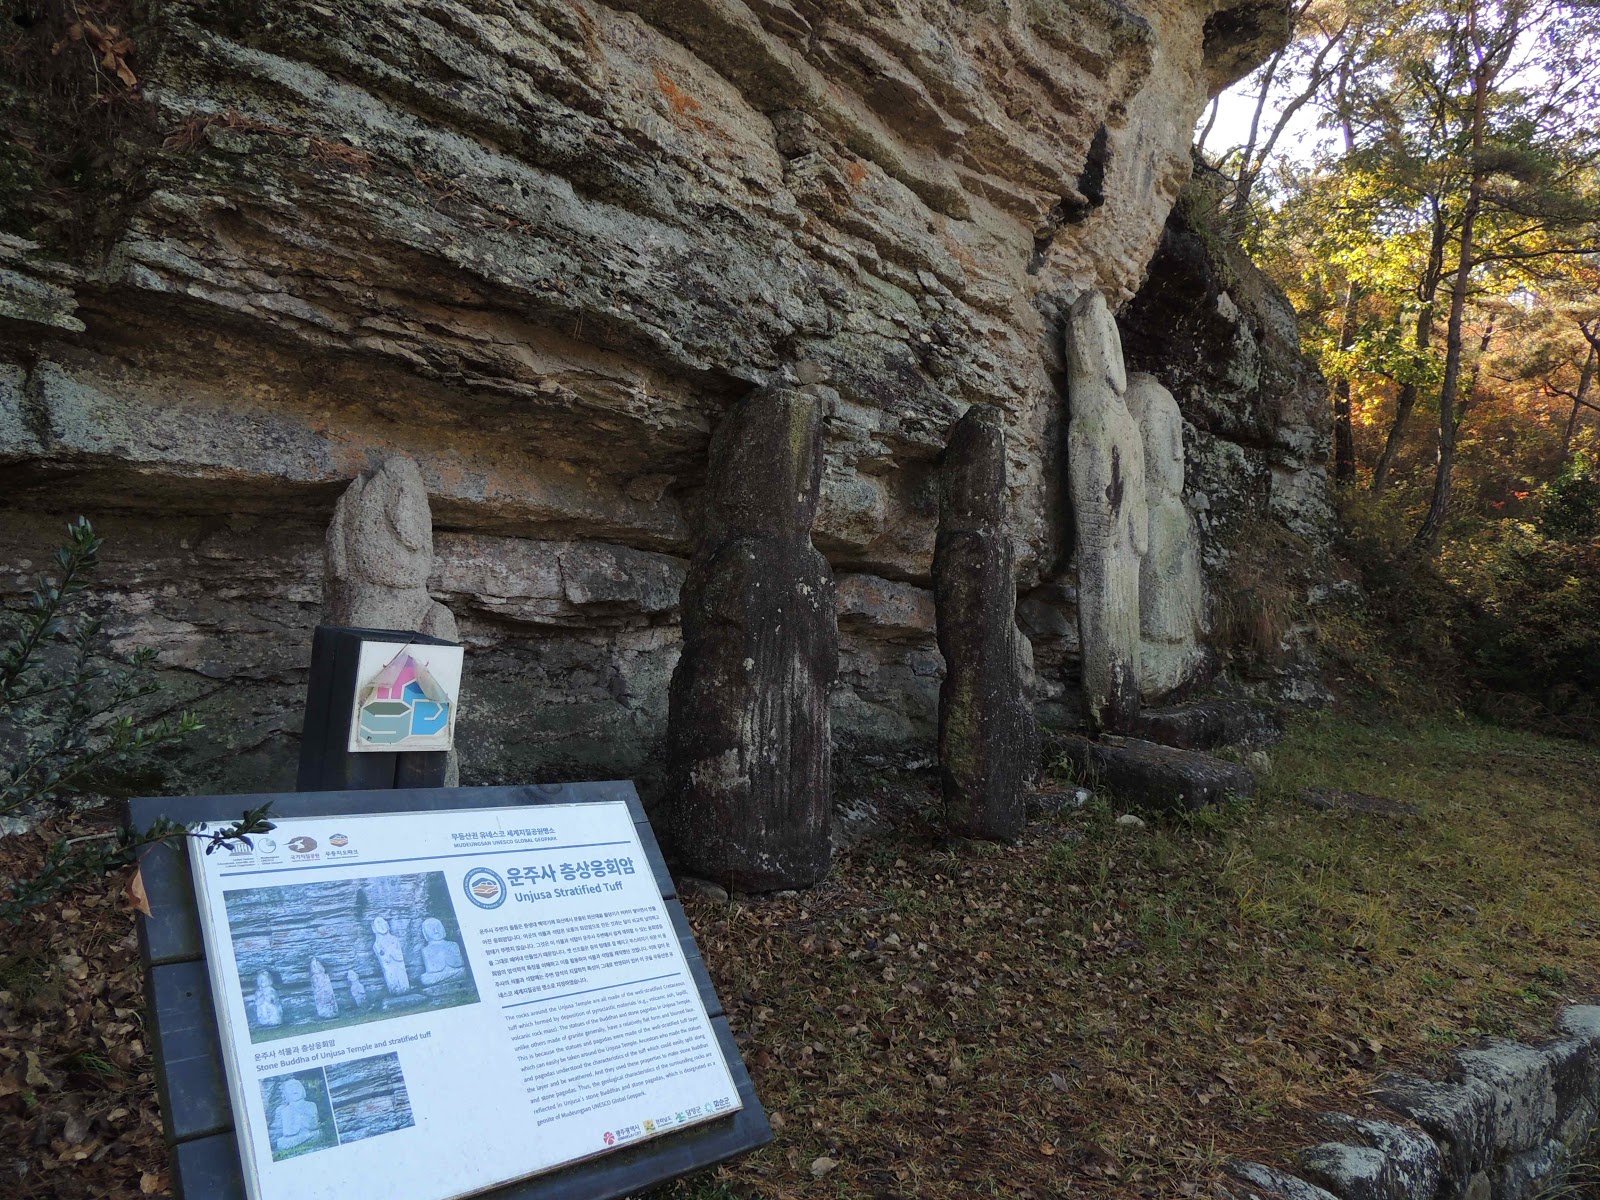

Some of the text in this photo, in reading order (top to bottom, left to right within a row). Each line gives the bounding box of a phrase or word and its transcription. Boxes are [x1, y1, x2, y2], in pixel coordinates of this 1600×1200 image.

[479, 830, 506, 839] 유네스코
[507, 857, 635, 887] 운주사 층상응회암
[514, 880, 623, 903] Unjusa Stratified Tuff
[530, 1008, 548, 1016] around
[634, 985, 663, 995] well-stratified
[511, 1033, 531, 1041] volcanic
[599, 1014, 618, 1022] Buddhas
[534, 1017, 553, 1025] formed
[560, 1011, 586, 1020] deposition
[254, 1039, 335, 1062] 운주사 석불과 층상응회암
[256, 1031, 431, 1072] Stone Buddha of Unjusa Temple and stratified tuff
[534, 1050, 555, 1058] because
[593, 1036, 613, 1045] pagodas
[651, 1020, 680, 1030] well-stratified
[521, 1064, 536, 1072] which
[581, 1049, 597, 1058] around
[605, 1044, 621, 1052] Unjusa
[621, 1040, 638, 1048] Temple.
[524, 1075, 534, 1083] and
[534, 1071, 556, 1081] pagodas
[556, 1063, 583, 1075] understood
[592, 1054, 624, 1066] characteristics
[568, 1072, 593, 1083] weathered.
[615, 1063, 627, 1071] used
[640, 1055, 662, 1065] properties
[530, 1096, 540, 1104] and
[555, 1088, 577, 1098] pagodas.
[601, 1074, 624, 1086] geological
[624, 1067, 655, 1079] characteristics
[533, 1104, 557, 1114] reflected
[563, 1096, 585, 1106] Unjusa's
[599, 1087, 621, 1097] Buddhas
[622, 1083, 631, 1091] and
[644, 1076, 665, 1085] pagodas,
[537, 1091, 646, 1127] geosite Mudeungsan UNESCO Global Geopark.
[685, 1106, 701, 1117] 담양군
[713, 1097, 730, 1107] 화순군
